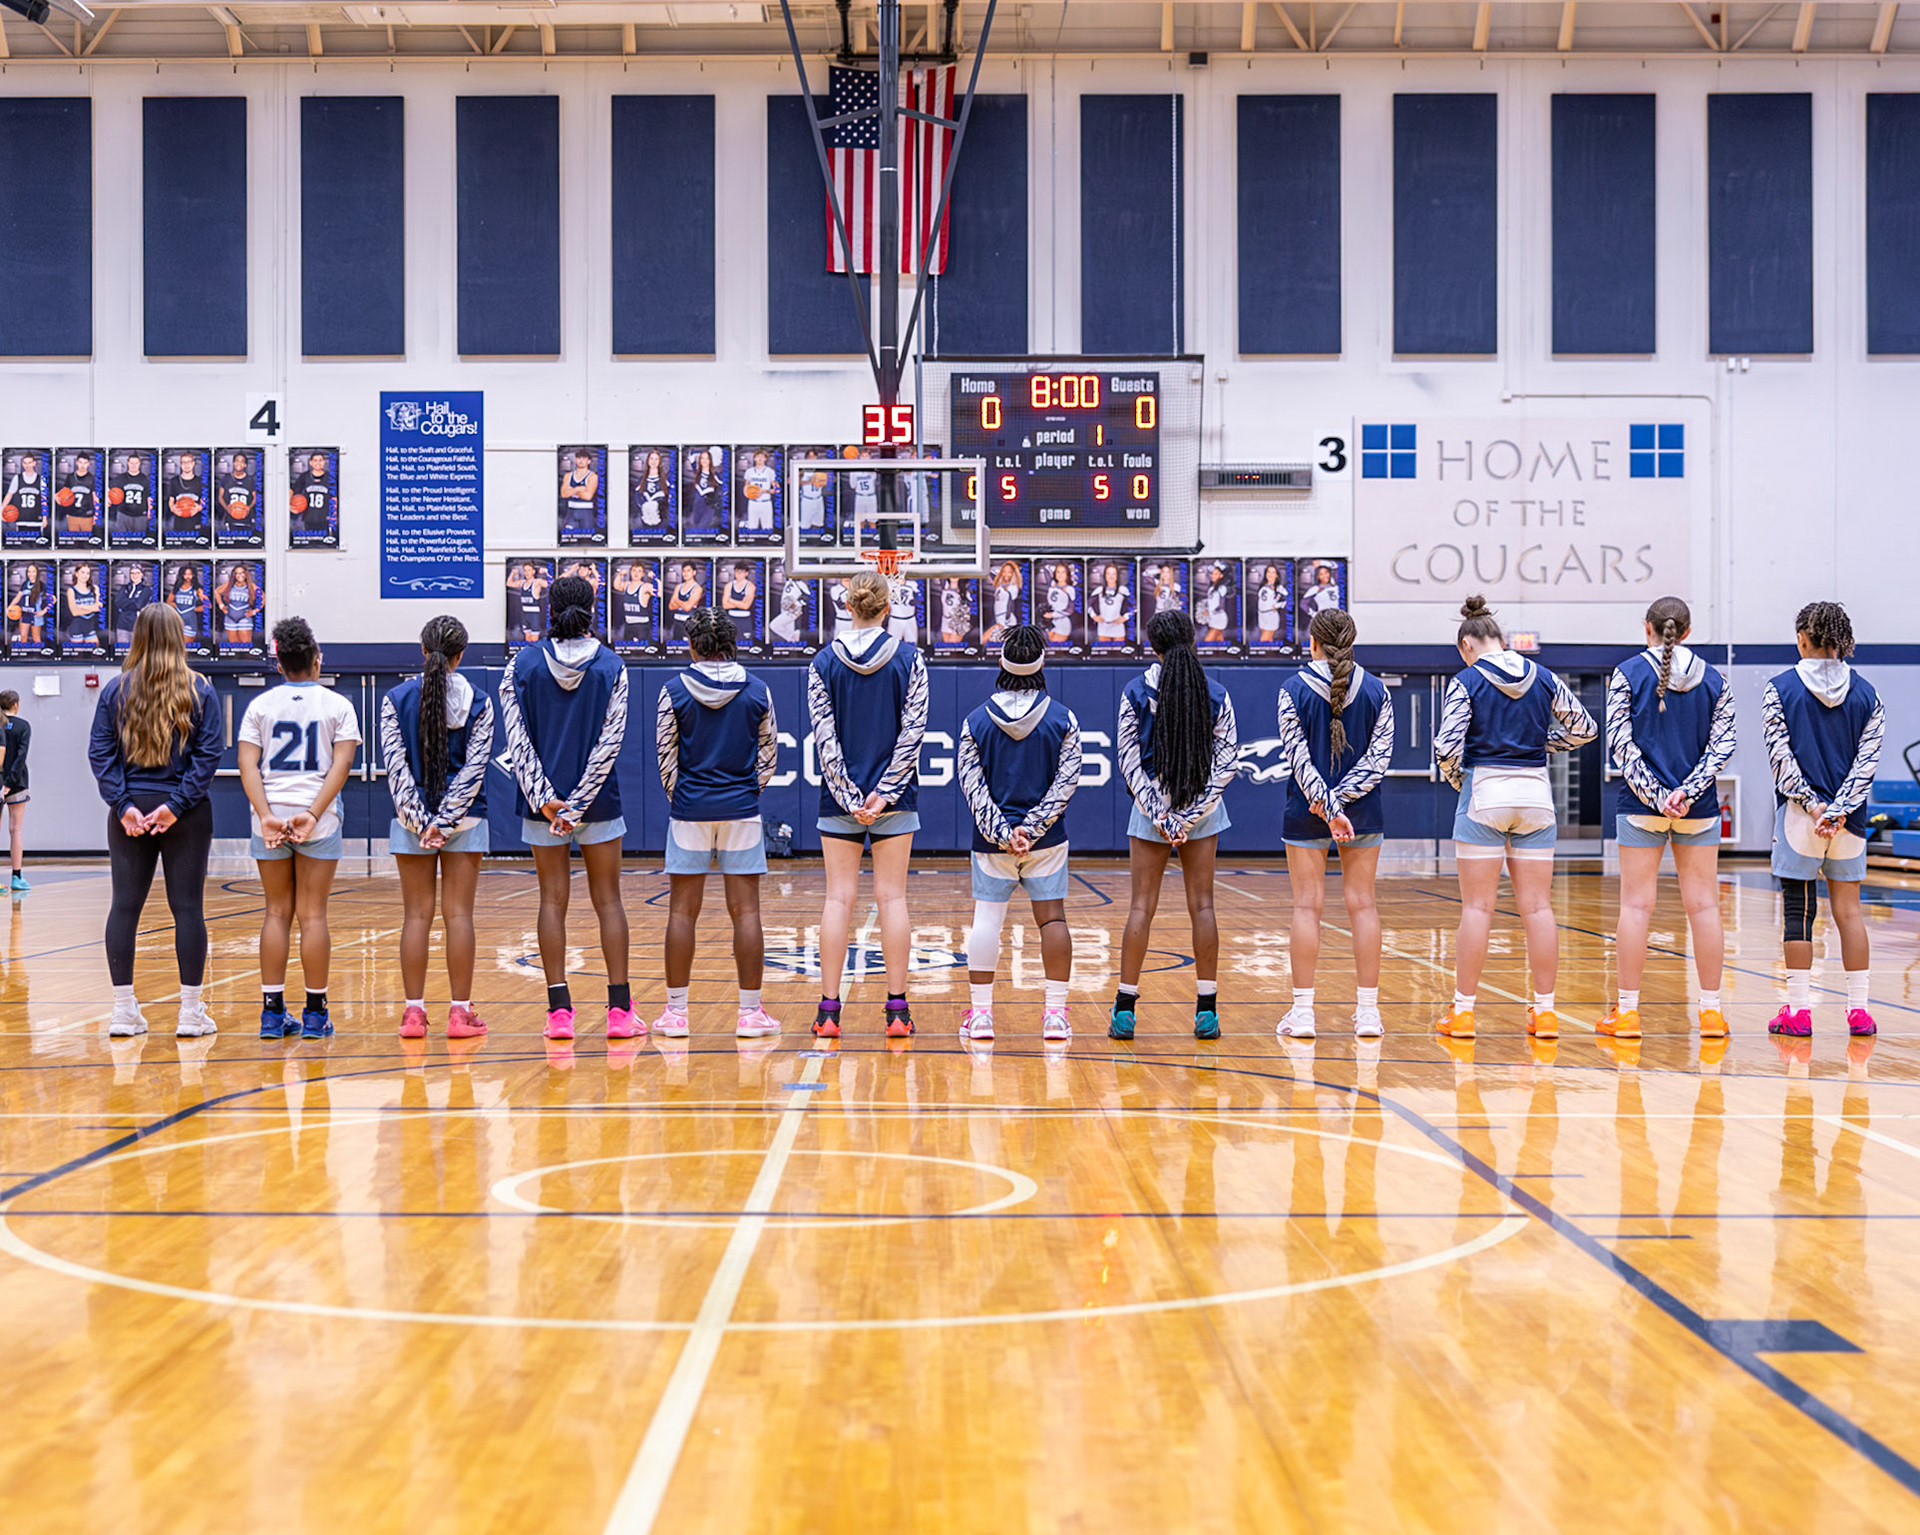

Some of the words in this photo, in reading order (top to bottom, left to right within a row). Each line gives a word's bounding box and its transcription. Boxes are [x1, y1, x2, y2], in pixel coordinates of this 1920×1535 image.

[961, 378, 996, 393] Home
[1031, 376, 1099, 408] 8:00
[1110, 377, 1154, 392] Guests
[249, 400, 281, 436] 4
[426, 401, 450, 414] Hail
[431, 412, 444, 424] to
[448, 411, 468, 424] the
[981, 396, 1000, 429] 0
[1136, 396, 1155, 428] 0
[420, 421, 478, 438] Cougars!
[864, 406, 912, 443] 35
[1036, 430, 1075, 446] period
[1096, 424, 1103, 446] 1
[1035, 452, 1076, 470] player
[1123, 454, 1152, 468] fouls
[1319, 436, 1347, 473] 3
[1436, 440, 1611, 482] HOME
[860, 481, 869, 491] 15
[1001, 476, 1016, 500] 5
[1094, 475, 1110, 500] 5
[1133, 475, 1149, 500] 0
[21, 495, 35, 508] 16
[75, 494, 83, 507] 7
[125, 492, 142, 504] 24
[309, 494, 324, 508] 18
[597, 498, 605, 528] CHASE
[960, 509, 976, 520] wo
[1040, 508, 1071, 522] game
[1126, 508, 1151, 520] won
[1453, 499, 1499, 527] OF
[1511, 500, 1586, 526] THE
[1391, 543, 1654, 585] COUGARS
[916, 603, 924, 628] COLE
[46, 618, 54, 641] ASIA
[269, 720, 320, 771] 21
